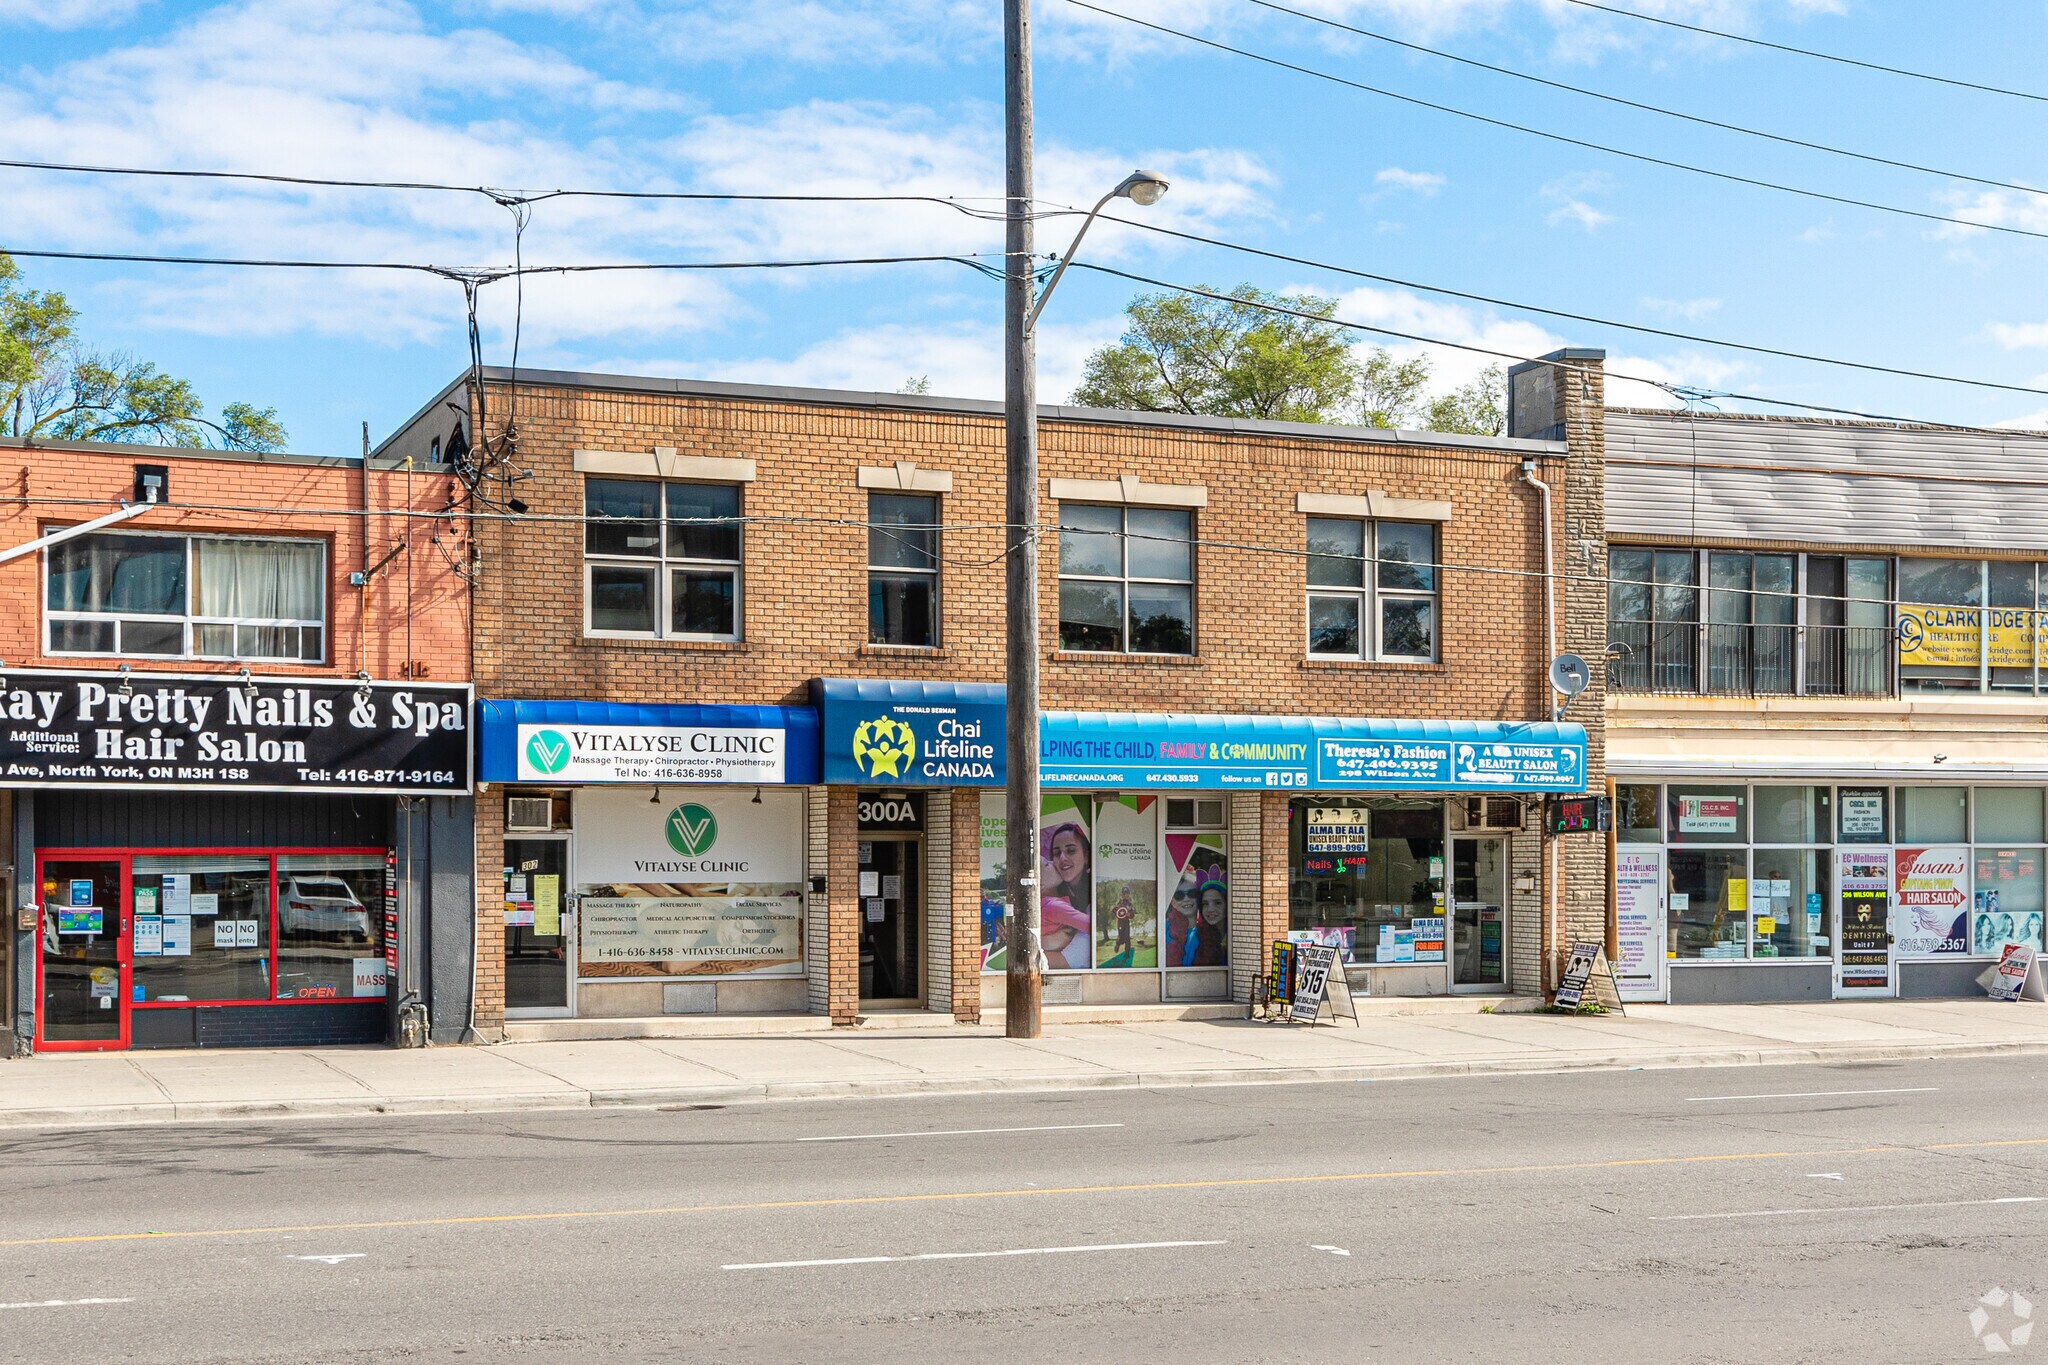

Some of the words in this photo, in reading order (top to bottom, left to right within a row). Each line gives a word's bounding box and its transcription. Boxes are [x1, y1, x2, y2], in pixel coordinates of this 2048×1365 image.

[1924, 610, 2024, 628] CLARKIDGE
[1930, 632, 1969, 642] HEALTH
[1972, 634, 1999, 643] CRE
[1922, 645, 1950, 653] website
[1560, 663, 1576, 673] Bell
[0, 690, 63, 728] ay
[77, 683, 213, 732] Pretty
[226, 687, 334, 728] Nails
[349, 689, 377, 728] &
[392, 692, 465, 737] Spa
[938, 719, 981, 738] Chai
[10, 730, 80, 743] Additional
[571, 731, 683, 752] VITALYSE
[690, 733, 775, 754] CLINIC
[26, 741, 80, 754] Service:
[95, 728, 185, 761] Hair
[198, 731, 307, 763] Salon
[924, 740, 994, 759] Lifeline
[1039, 740, 1083, 758] LPING
[1085, 741, 1112, 759] THE
[1114, 741, 1157, 761] CHILD,
[1159, 742, 1207, 760] FAMILY
[1209, 742, 1220, 760] &
[1324, 742, 1391, 759] Theresa's
[1393, 744, 1447, 759] Fashion
[1483, 746, 1492, 756] A
[1513, 747, 1554, 758] UNISEX
[573, 756, 611, 765] Massage
[614, 757, 650, 766] Therapy
[655, 757, 708, 767] Chiropractor
[715, 758, 776, 768] Physiotherapy
[1336, 758, 1438, 770] 647.406.9395
[1478, 758, 1522, 769] BEAUTY
[1522, 760, 1558, 771] SALON
[7, 764, 44, 778] Ave,
[49, 765, 97, 778] North
[101, 766, 144, 780] York,
[148, 767, 174, 779] ON
[178, 767, 214, 779] M3H
[219, 768, 249, 780] 1S8
[297, 768, 331, 782] Tel:
[335, 769, 455, 783] 416-871-9164
[615, 768, 629, 778] Tel
[633, 769, 651, 778] No:
[654, 768, 722, 779] 416-636-8958
[923, 762, 995, 778] CANADA
[1364, 770, 1410, 778] Wilson
[1039, 773, 1124, 782] LIFELINECANADA.ORG
[1146, 773, 1199, 782] 647.430.5933
[1221, 775, 1242, 783] follow
[858, 801, 916, 822] 300A
[981, 827, 1007, 837] ives
[1309, 826, 1333, 834] ALMA
[1335, 826, 1346, 834] DE
[1348, 826, 1364, 834] ALA
[1309, 835, 1328, 843] UNISEX
[1328, 835, 1348, 843] BEAUTY
[1349, 835, 1365, 843] SALON
[1307, 859, 1332, 869] Nails
[1342, 857, 1367, 865] HAIR
[1627, 856, 1631, 864] E
[1635, 856, 1640, 864] C
[1842, 854, 1852, 863] EC
[1853, 853, 1888, 863] Wellness
[522, 860, 538, 871] 302
[634, 860, 697, 872] VITALYSE
[700, 860, 749, 872] CLINIC
[1617, 864, 1628, 872] ALTH
[1633, 864, 1658, 872] WELLNESS
[1907, 892, 1930, 904] HAIR
[1931, 892, 1961, 904] SALON
[217, 925, 233, 934] NO
[239, 925, 255, 934] NO
[238, 937, 256, 946] entry
[1842, 932, 1886, 940] DENTISTRY
[1415, 942, 1427, 950] FOR
[1427, 942, 1443, 950] RENT
[1899, 938, 1966, 952] 416.738.5367
[598, 946, 674, 957] 1-416-636-8458
[682, 946, 784, 956] VITALYSECLINIC.COM
[1842, 955, 1852, 963] Tel:
[1852, 955, 1862, 963] 647
[1874, 955, 1887, 963] 4453
[356, 974, 386, 986] MASS
[1301, 968, 1325, 994] $15
[298, 986, 337, 999] OPEN
